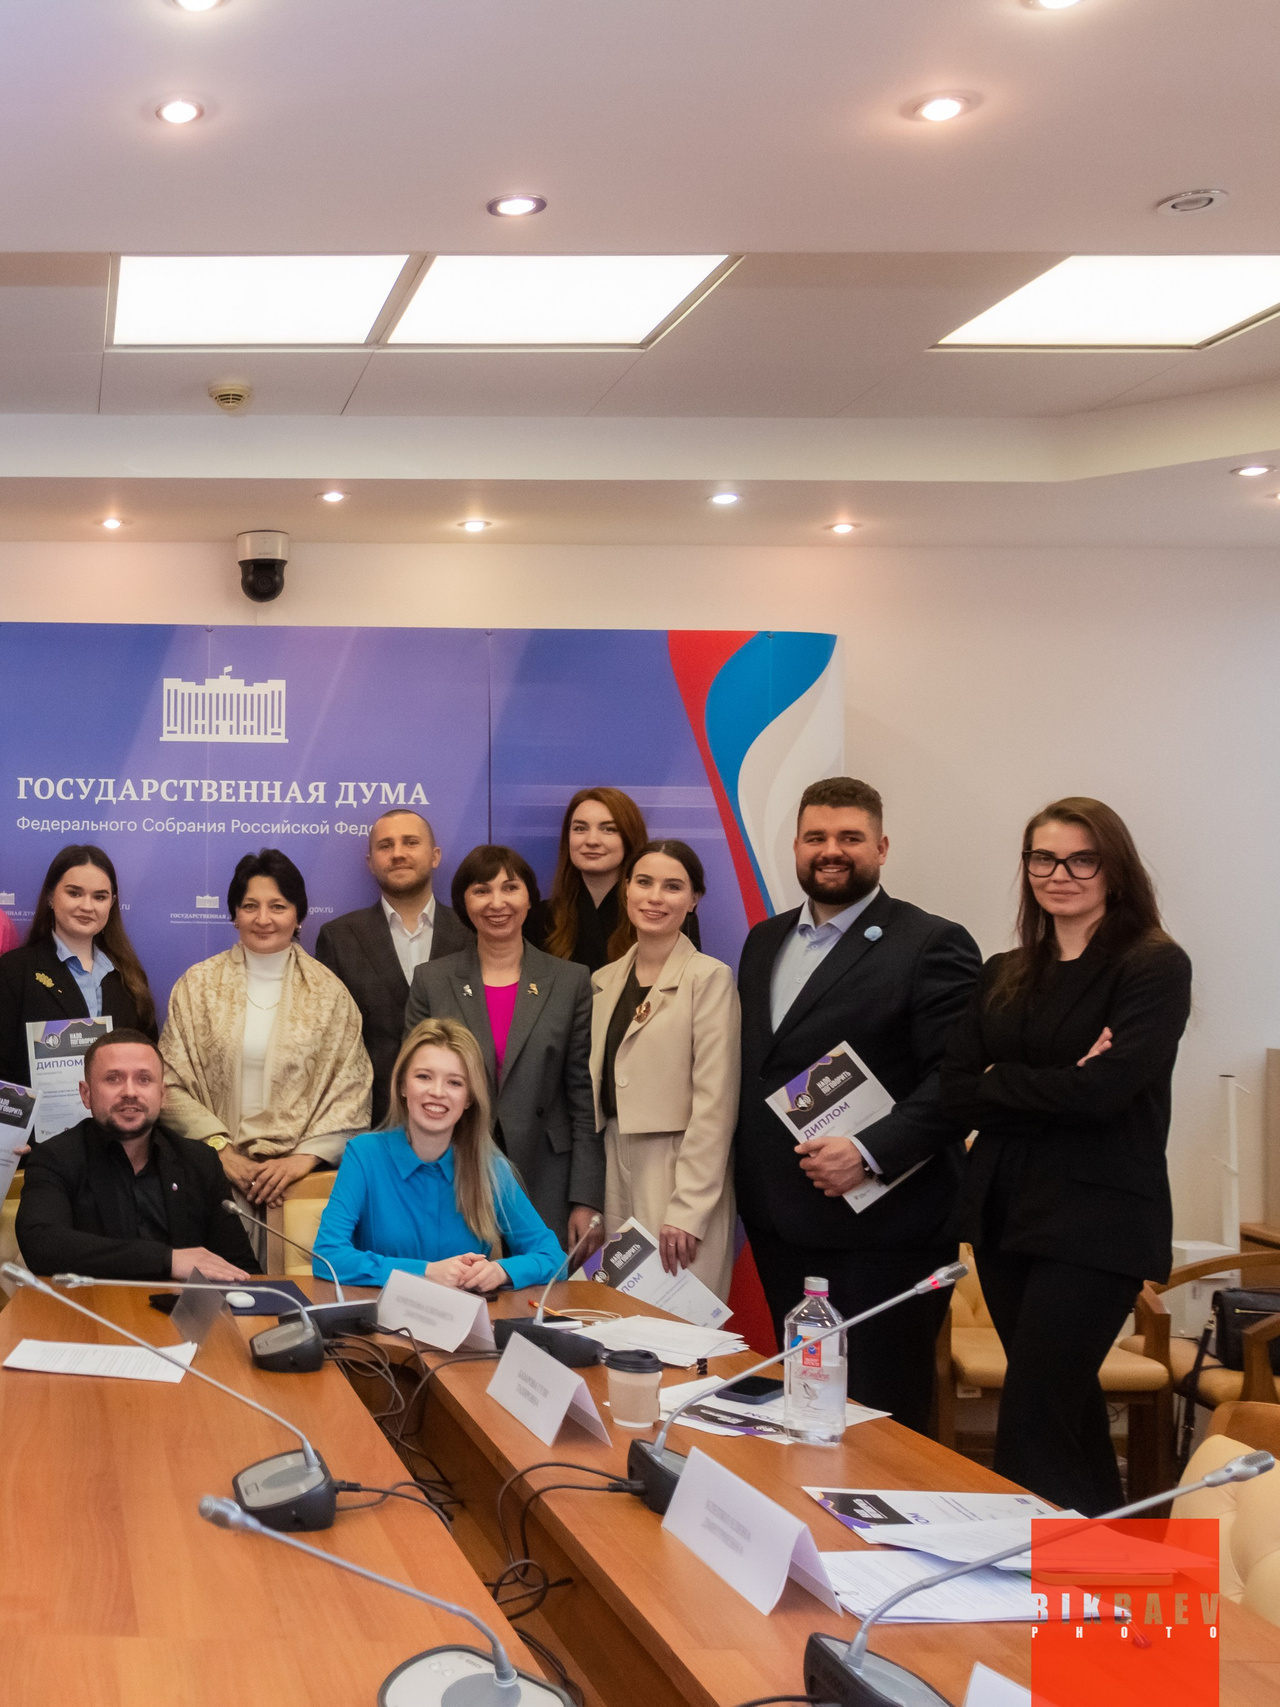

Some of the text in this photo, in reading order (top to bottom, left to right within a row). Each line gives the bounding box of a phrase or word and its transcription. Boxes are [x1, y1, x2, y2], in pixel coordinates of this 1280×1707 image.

[16, 776, 431, 808] ГОСУДАРСТВЕННАЯ ДУМА
[16, 815, 138, 834] Федерального
[142, 816, 226, 835] Собрания
[230, 819, 330, 835] Российской
[307, 906, 334, 916] .gov.ru
[36, 1058, 83, 1071] ДИПЛОМ
[803, 1101, 851, 1140] ДИПЛОМ
